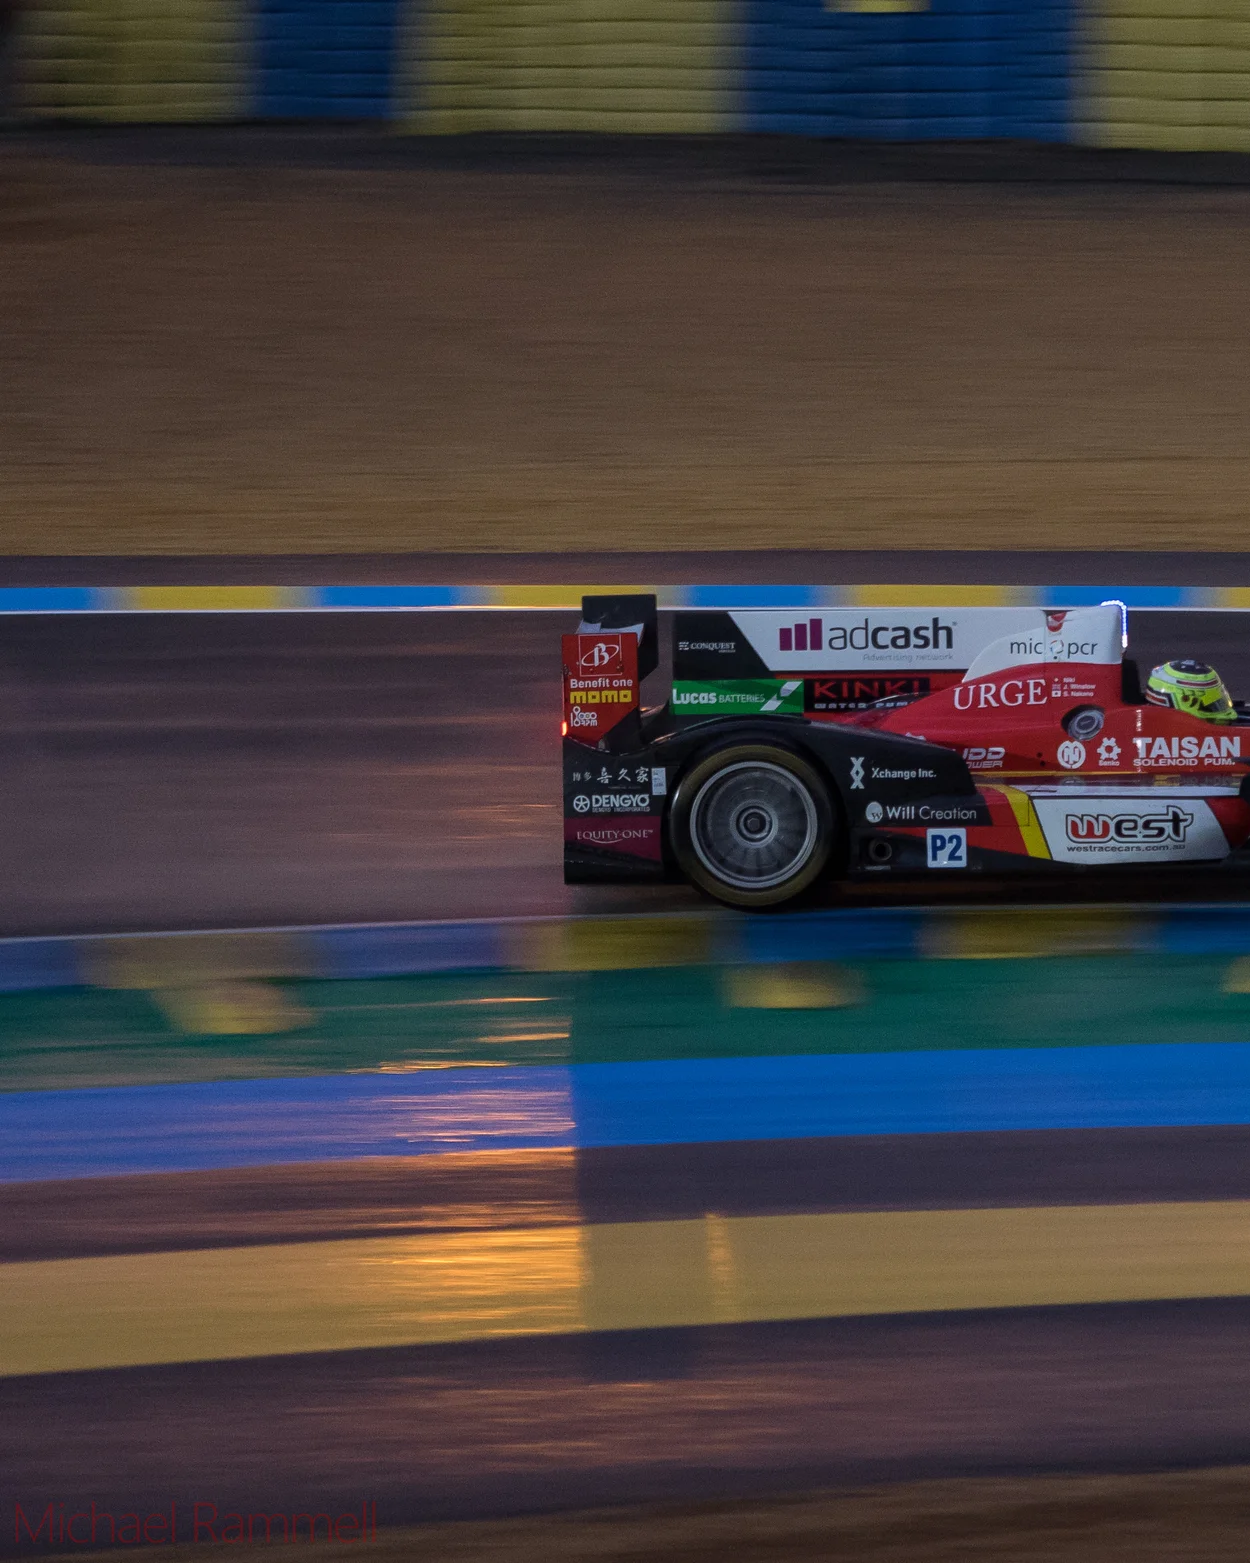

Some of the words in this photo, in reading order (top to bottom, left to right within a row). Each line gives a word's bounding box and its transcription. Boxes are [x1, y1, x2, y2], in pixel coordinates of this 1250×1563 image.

[828, 617, 953, 650] adcash
[690, 642, 736, 651] CONQUEST
[863, 653, 913, 663] Advertising
[915, 653, 954, 661] network
[570, 678, 610, 688] Benefit
[612, 679, 633, 687] one
[814, 680, 920, 698] KINKI
[570, 690, 632, 704] momo
[672, 688, 717, 704] Lucas
[718, 693, 766, 703] BATTERIES
[953, 679, 1047, 710] URGE
[1133, 736, 1241, 758] TAISAN
[1133, 758, 1198, 767] SOLENOID
[1204, 758, 1236, 766] PUM.
[872, 768, 917, 780] Xchange
[918, 768, 937, 778] Inc.
[592, 794, 650, 808] DENGYO
[886, 806, 915, 820] Will
[919, 806, 977, 820] Creation
[1066, 805, 1194, 844] west
[931, 834, 963, 861] P2
[1067, 844, 1186, 853] westracecars.com.au
